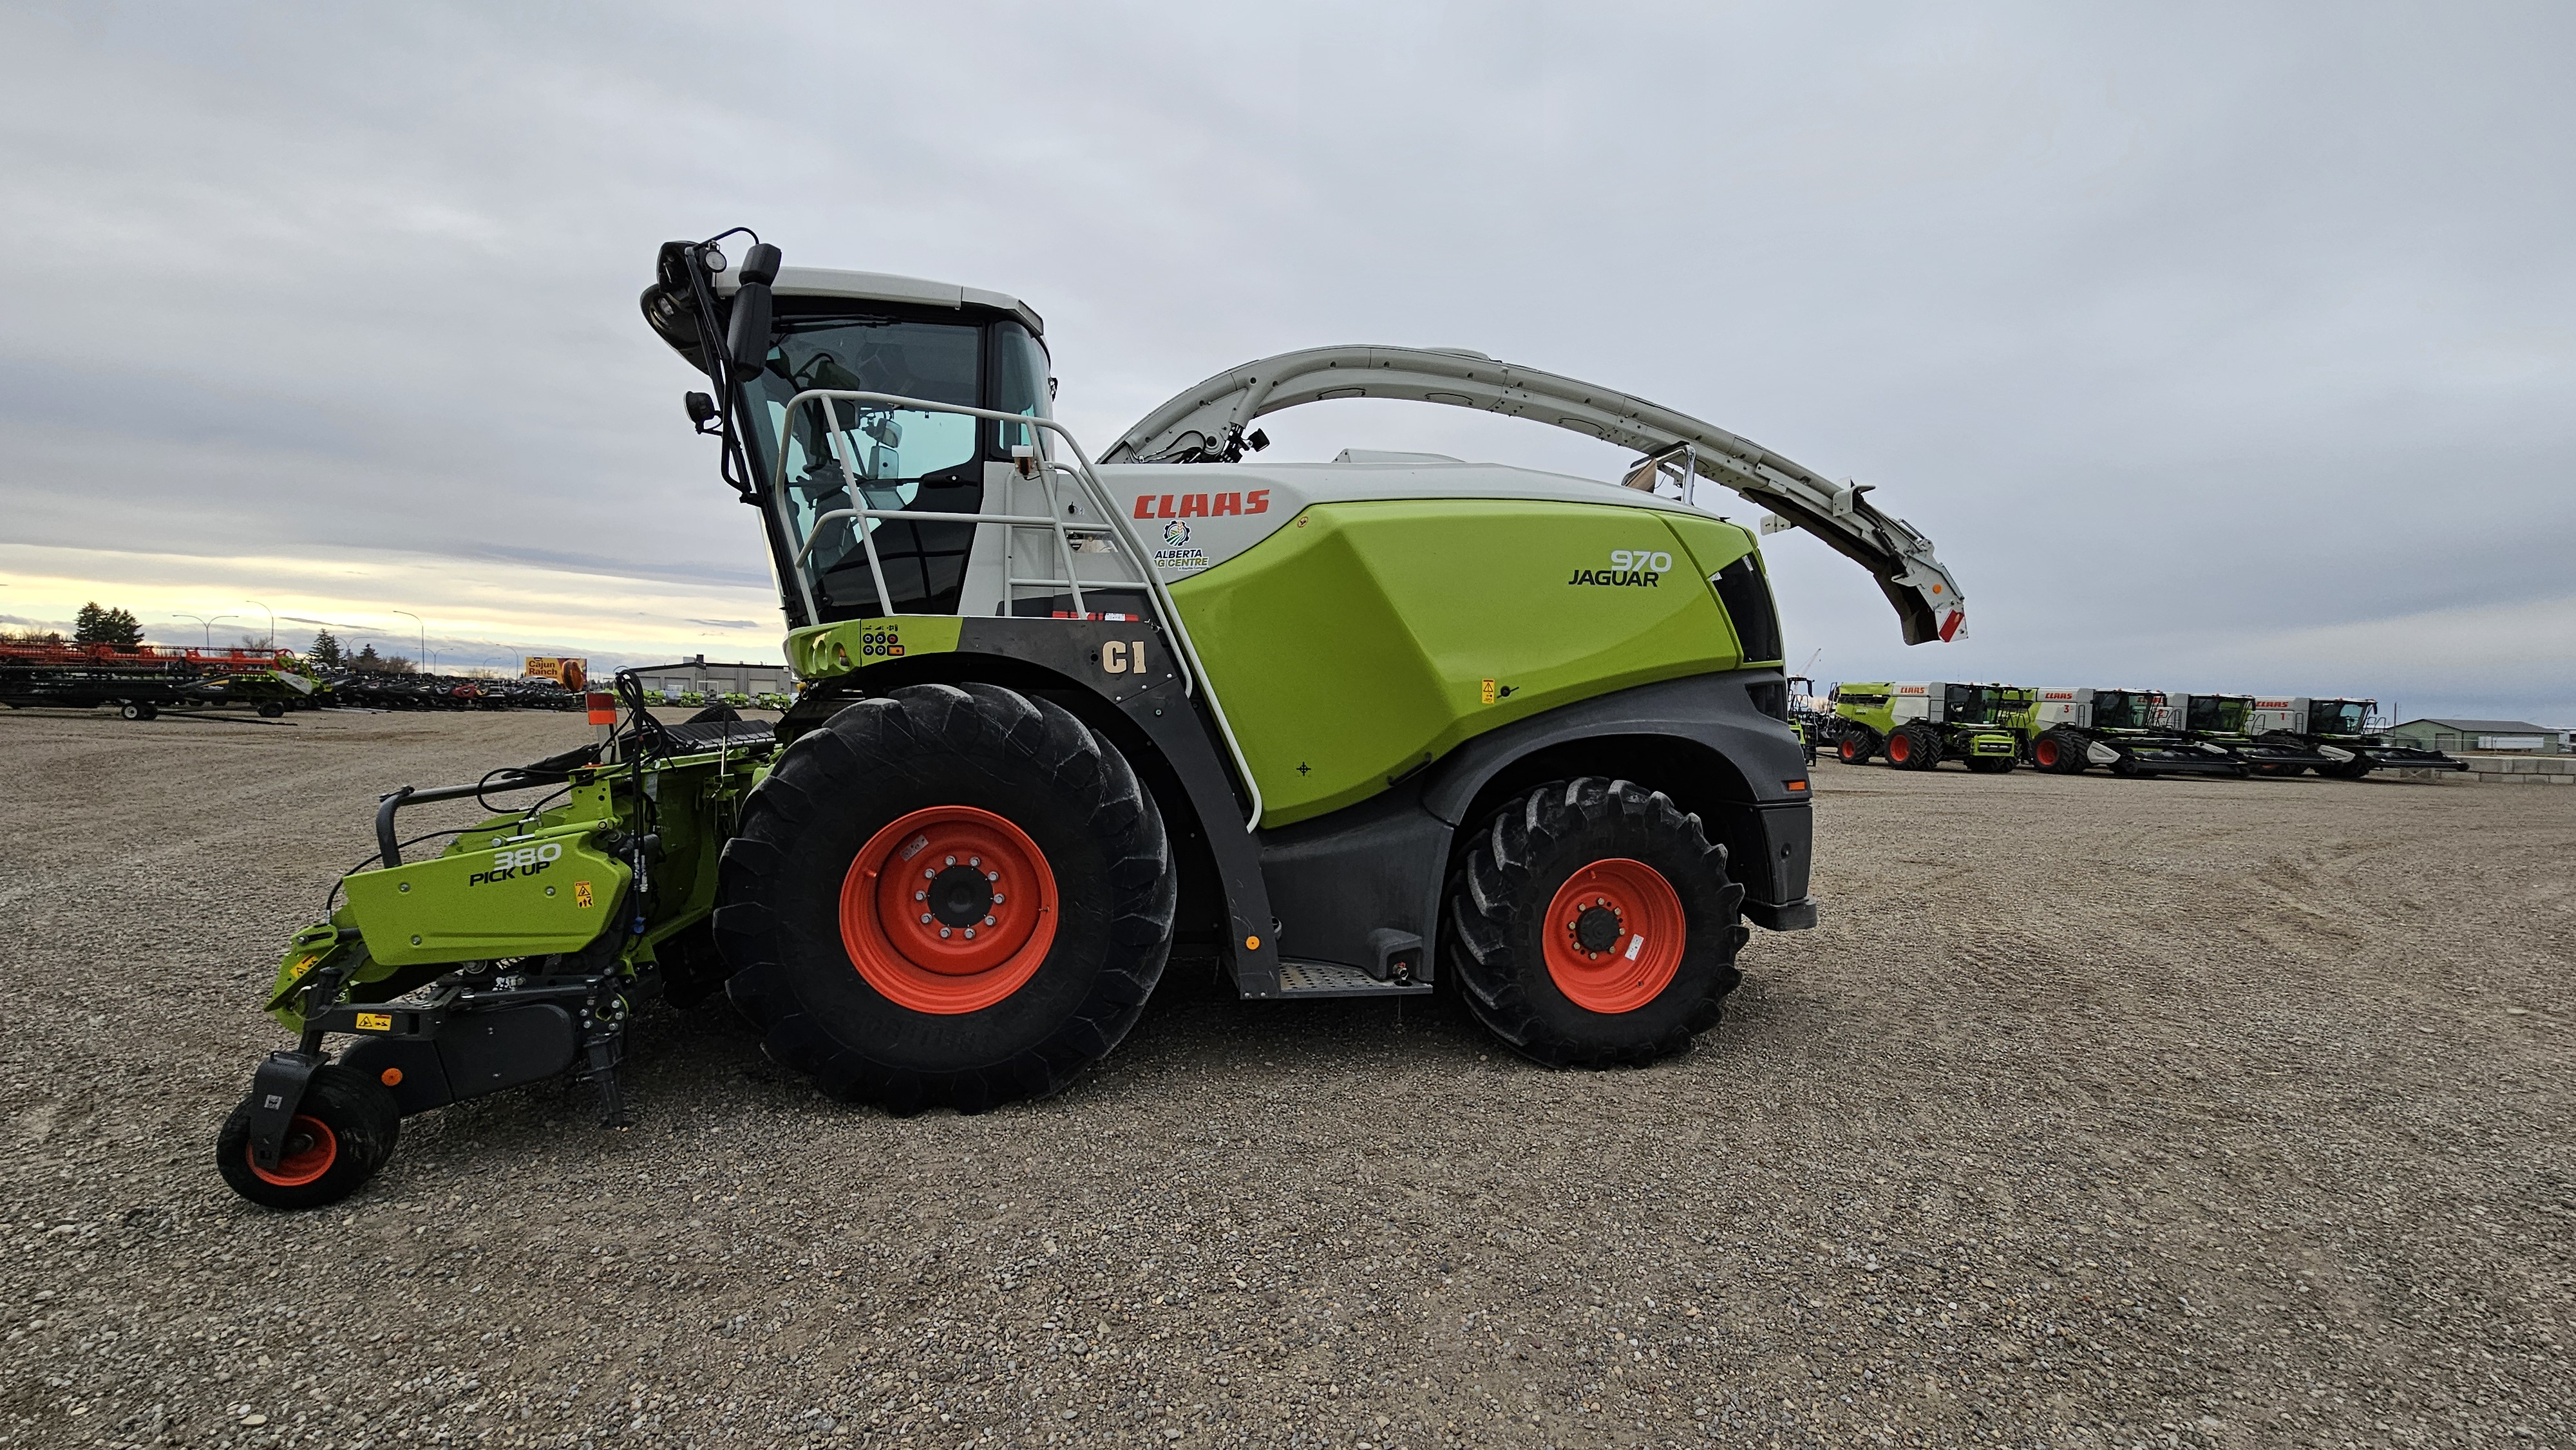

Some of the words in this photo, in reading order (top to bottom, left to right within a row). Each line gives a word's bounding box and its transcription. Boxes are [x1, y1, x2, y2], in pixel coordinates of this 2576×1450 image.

[1133, 489, 1270, 519] CLAAS
[1154, 549, 1202, 560] ALBERTA
[1168, 558, 1208, 567] CENTRE
[1611, 550, 1672, 572] 970
[1568, 569, 1659, 587] JAGUAR
[528, 661, 555, 669] Cajun
[2063, 704, 2070, 713] 3
[494, 843, 562, 872] 380
[469, 867, 516, 887] PICK
[522, 861, 550, 876] UP
